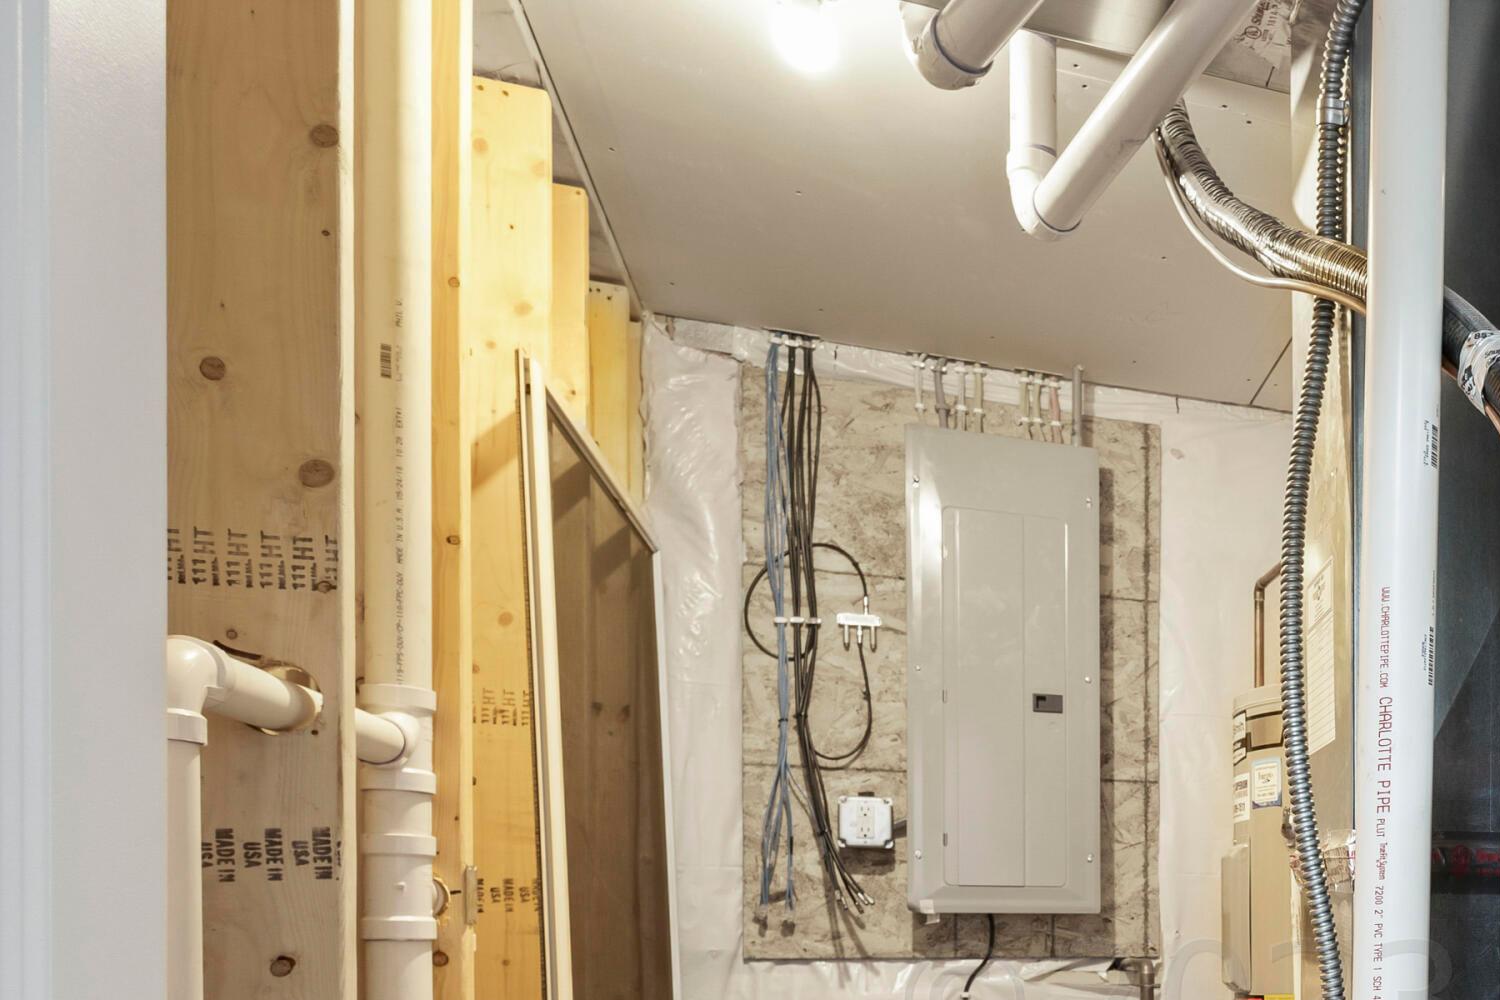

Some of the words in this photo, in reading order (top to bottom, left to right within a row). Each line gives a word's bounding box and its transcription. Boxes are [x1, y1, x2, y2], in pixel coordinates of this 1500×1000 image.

[193, 526, 216, 555] HT
[227, 528, 250, 557] HT
[260, 530, 284, 558] HT
[292, 536, 315, 561] HT
[1377, 696, 1393, 772] CHARLOTTE
[1376, 779, 1391, 813] PIPE
[215, 827, 236, 865] MADE
[242, 841, 263, 868] USA
[265, 827, 285, 865] MADE
[291, 840, 311, 867] USA
[312, 826, 334, 863] MADE
[1374, 886, 1384, 905] 7200
[1373, 923, 1384, 938] PVC
[1373, 943, 1383, 963] TYPE
[1373, 976, 1383, 991] SCH
